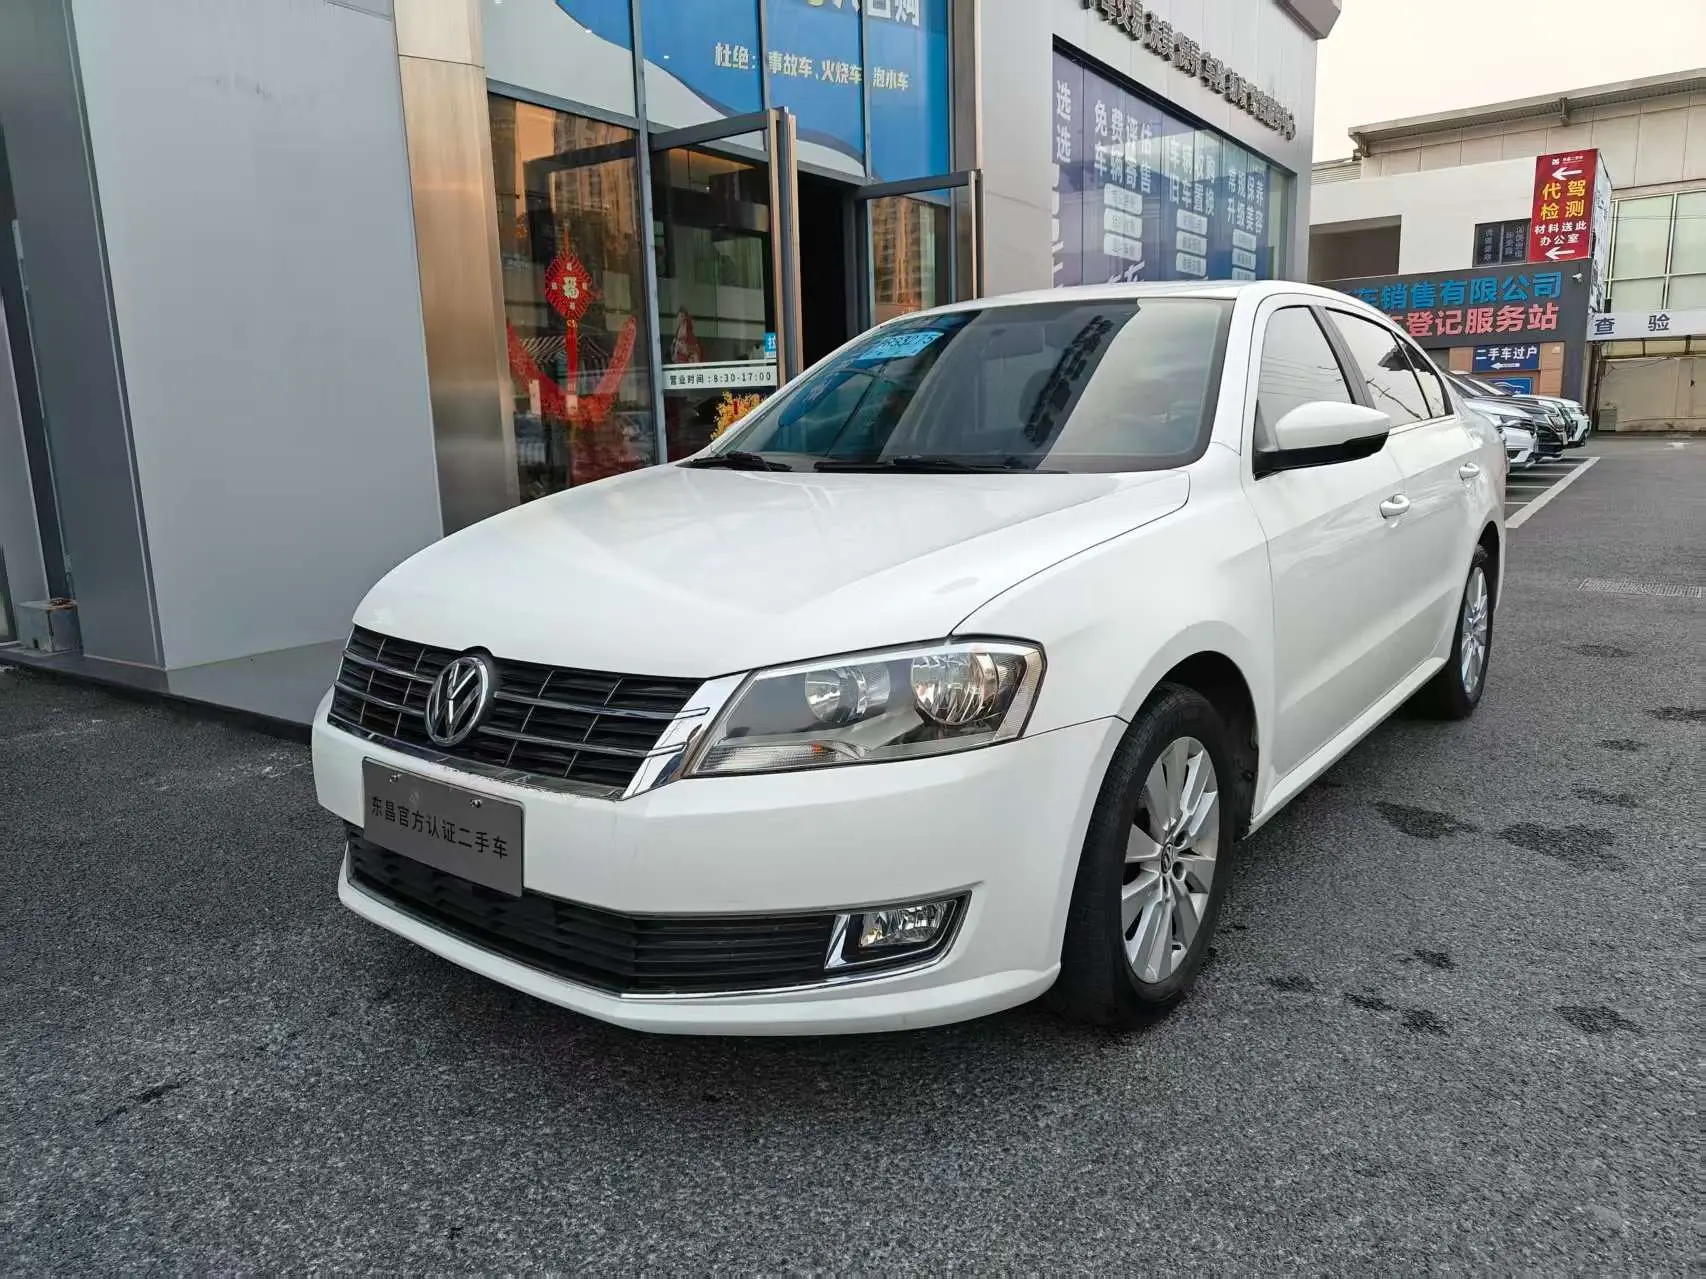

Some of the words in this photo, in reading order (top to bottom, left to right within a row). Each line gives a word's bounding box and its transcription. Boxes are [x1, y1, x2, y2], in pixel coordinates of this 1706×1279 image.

[1542, 180, 1586, 200] 代驾
[1540, 200, 1584, 220] 检测
[1535, 220, 1587, 235] 材料送此
[1540, 234, 1580, 246] 办公室
[1391, 302, 1560, 337] 登记服务站
[1475, 345, 1538, 361] 二手车过户
[371, 796, 508, 860] 东昌官方认证二手车
